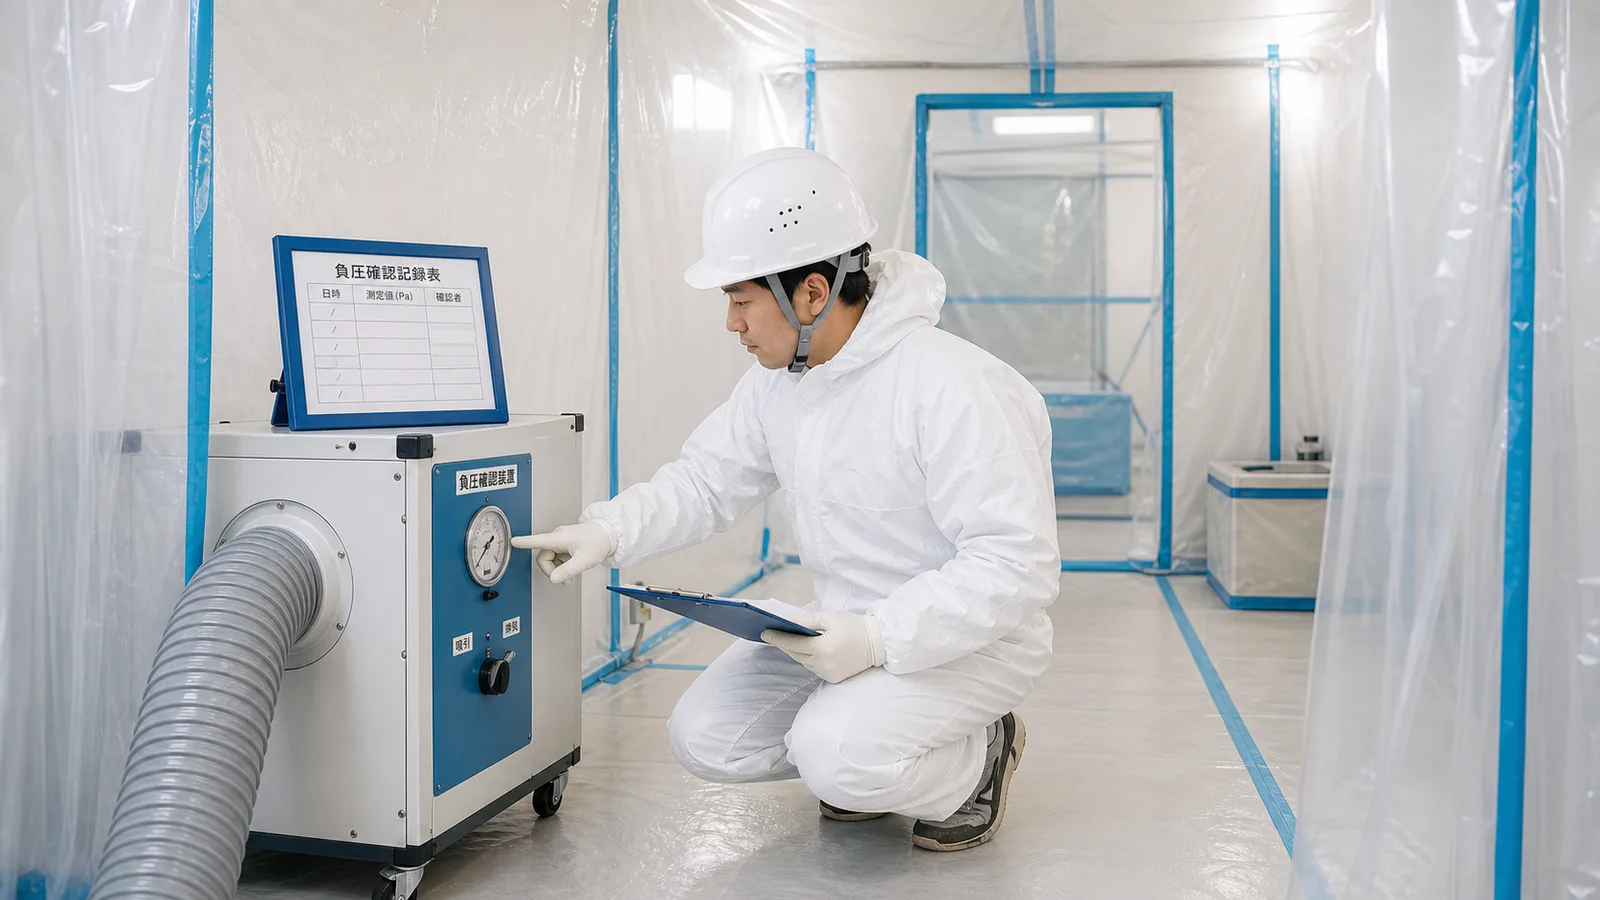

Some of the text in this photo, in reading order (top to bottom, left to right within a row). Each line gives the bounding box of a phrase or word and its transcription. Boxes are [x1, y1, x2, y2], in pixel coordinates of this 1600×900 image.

[335, 263, 441, 282] 負圧確認記録表
[459, 469, 515, 491] 負圧確認装置
